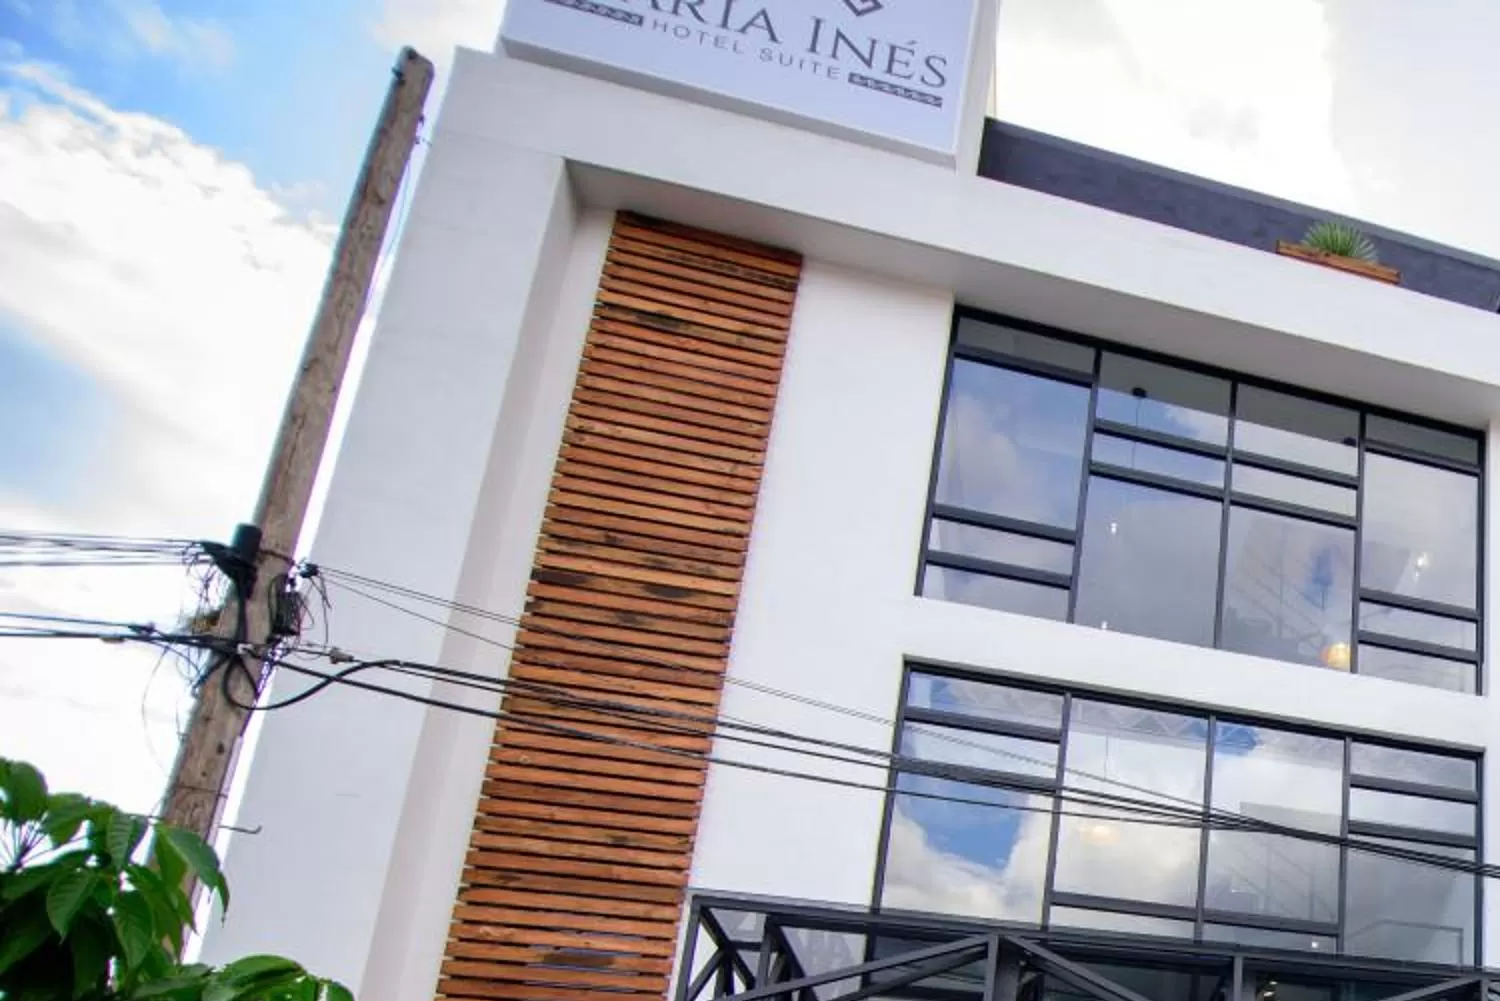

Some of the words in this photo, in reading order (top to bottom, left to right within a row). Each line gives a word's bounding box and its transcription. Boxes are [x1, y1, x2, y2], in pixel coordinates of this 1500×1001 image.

[651, 18, 745, 54] HOTEL
[759, 47, 841, 81] SUITE
[805, 15, 948, 88] INÉS
